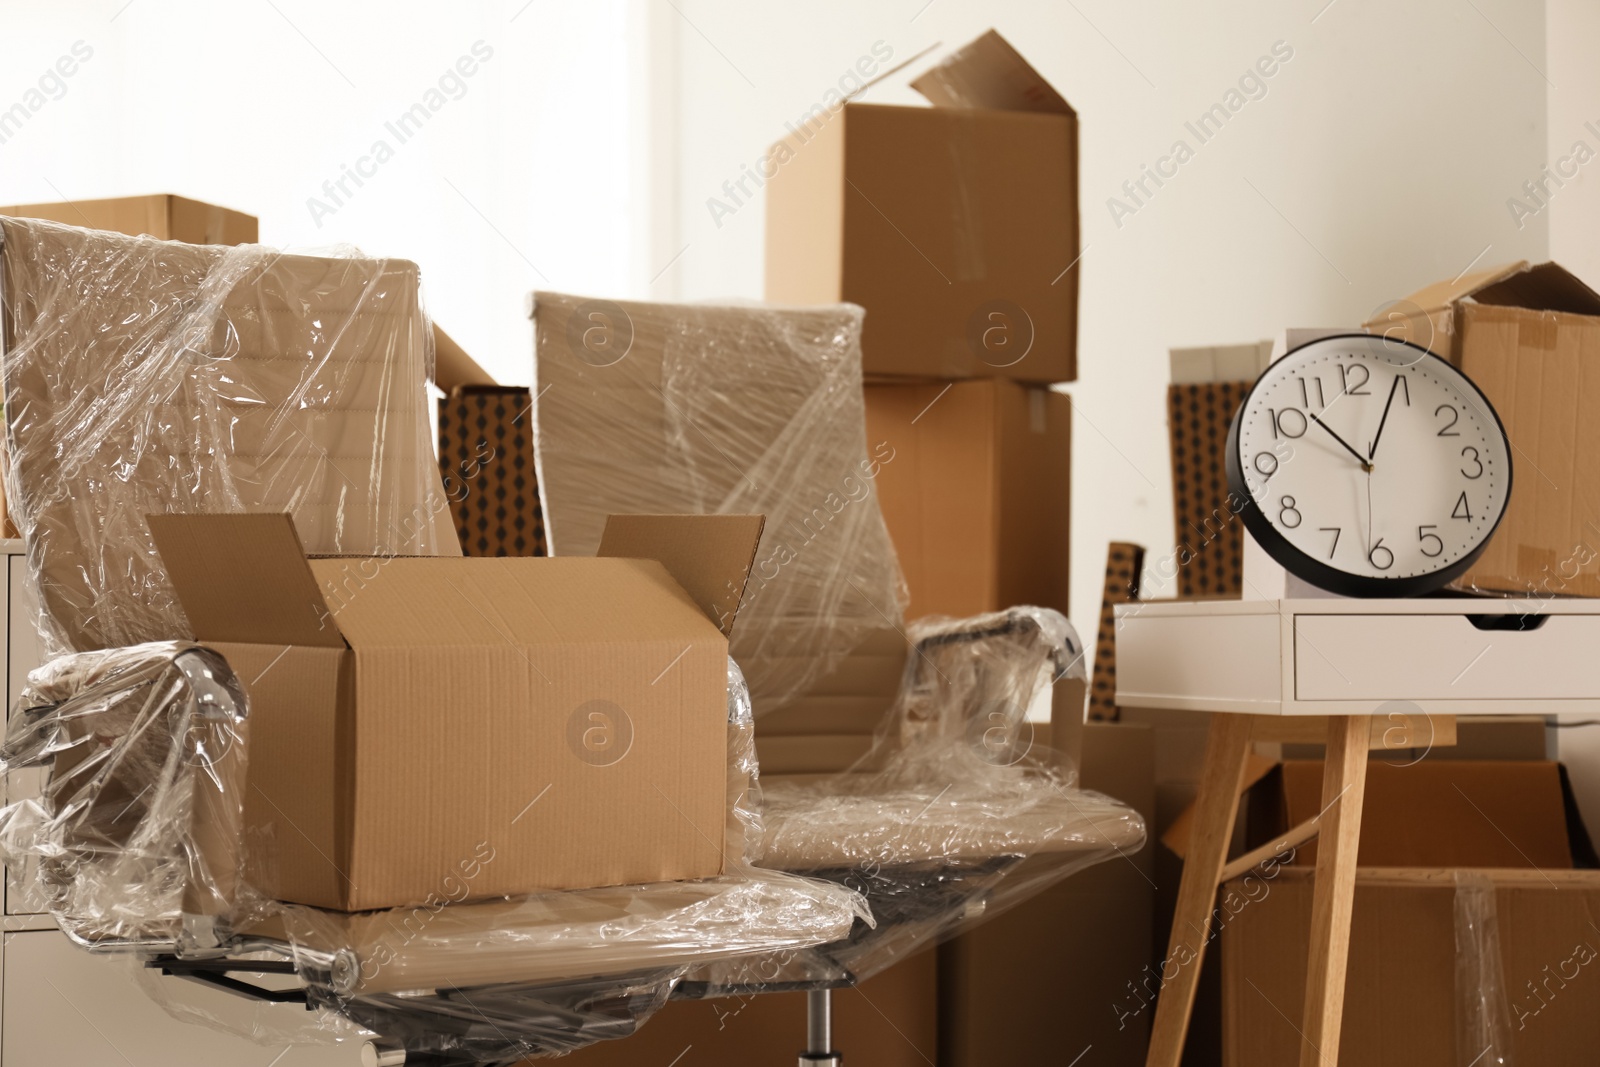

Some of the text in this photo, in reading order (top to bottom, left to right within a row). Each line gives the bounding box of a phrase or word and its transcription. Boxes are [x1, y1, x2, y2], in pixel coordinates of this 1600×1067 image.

[1298, 377, 1325, 408] 11
[1338, 363, 1371, 395] 12
[1399, 375, 1410, 406] 1
[1268, 407, 1308, 439] 10
[1435, 404, 1460, 436] 2
[1254, 451, 1278, 483] 9
[1461, 446, 1483, 479] 3
[1279, 495, 1302, 528] 8
[1451, 491, 1474, 523] 4
[1319, 528, 1341, 559] 7
[1369, 538, 1394, 570] 6
[1419, 525, 1443, 557] 5
